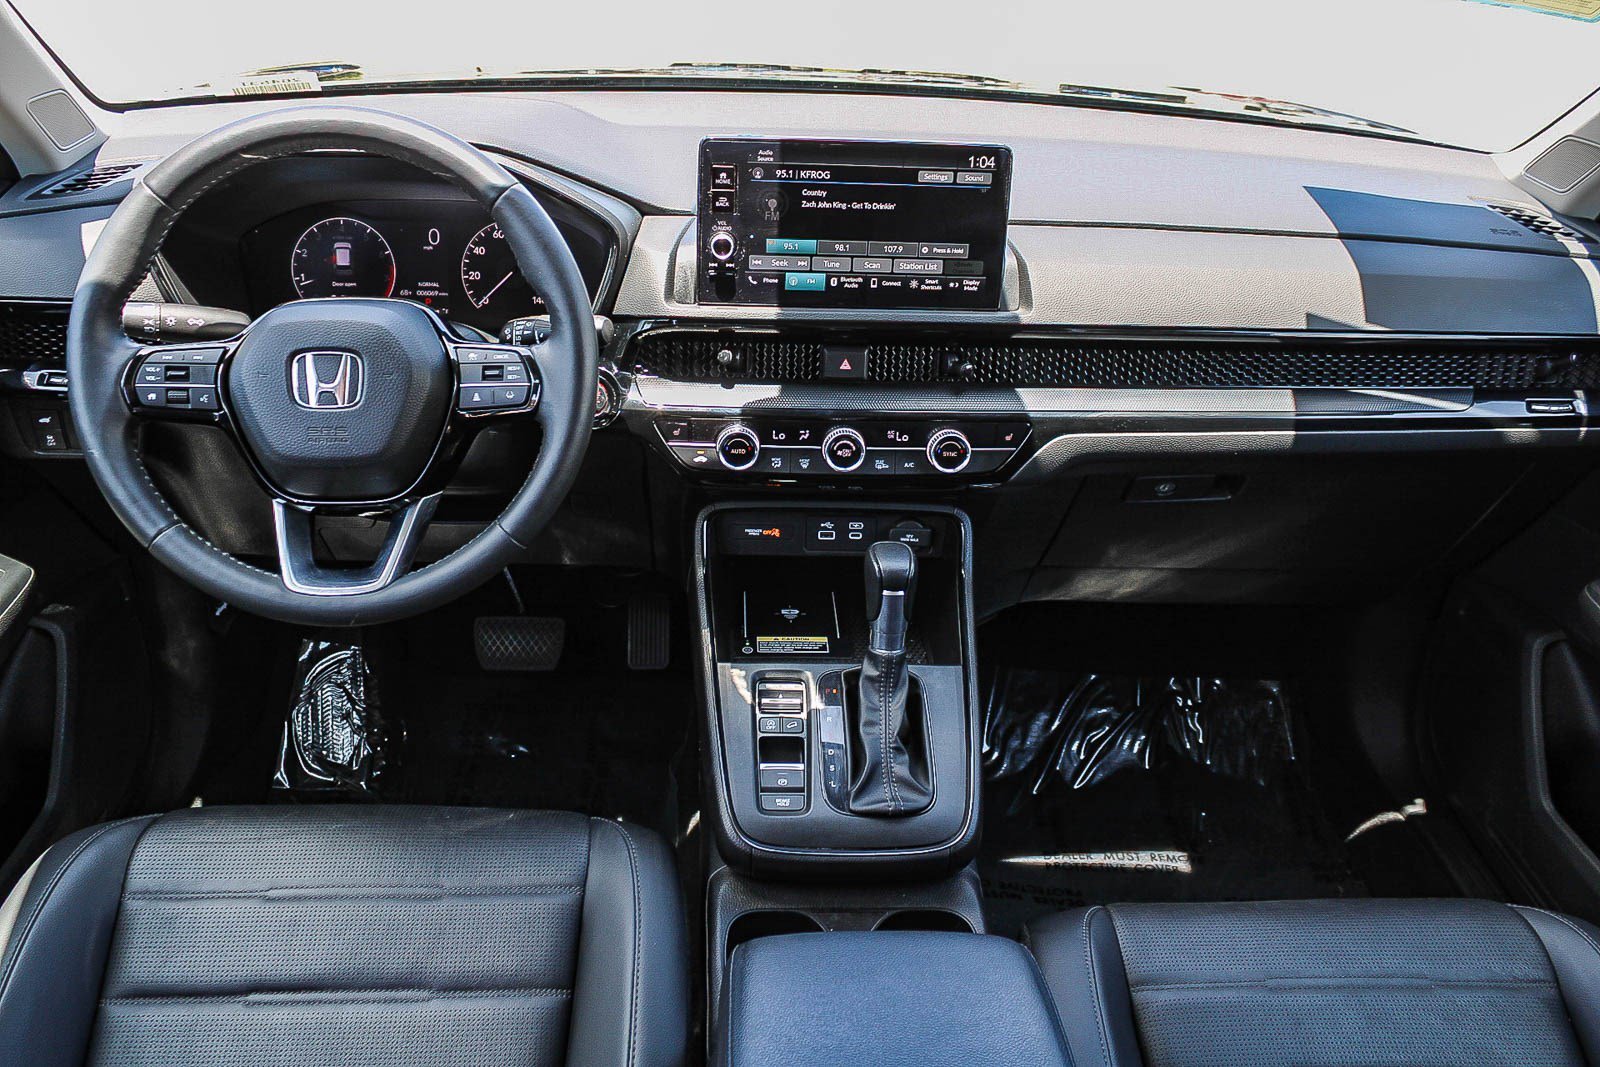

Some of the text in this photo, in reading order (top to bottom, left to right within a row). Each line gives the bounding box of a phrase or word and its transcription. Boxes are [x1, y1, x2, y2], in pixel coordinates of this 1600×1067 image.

[968, 156, 996, 169] 1:04
[775, 169, 831, 180] 95.1 KFROG
[923, 173, 948, 182] Settings
[964, 174, 984, 182] Sound
[801, 188, 827, 198] Country
[801, 200, 817, 208] Zach
[817, 201, 832, 209] John
[833, 201, 847, 210] King
[851, 202, 863, 210] Get
[864, 202, 872, 210] To
[764, 211, 780, 221] FM
[473, 246, 486, 256] 40
[783, 242, 799, 251] 95.1
[834, 244, 850, 252] 98.1
[883, 245, 904, 254] 107.9
[301, 248, 309, 258] 2
[771, 259, 789, 267] Seek
[823, 260, 841, 268] Tune
[863, 261, 881, 270] Scan
[899, 262, 938, 272] Station List
[300, 273, 305, 282] 1
[468, 271, 481, 281] 20
[881, 280, 902, 288] Connect
[772, 430, 786, 440] Lo
[896, 431, 909, 442] Lo
[1103, 852, 1141, 862] MUST
